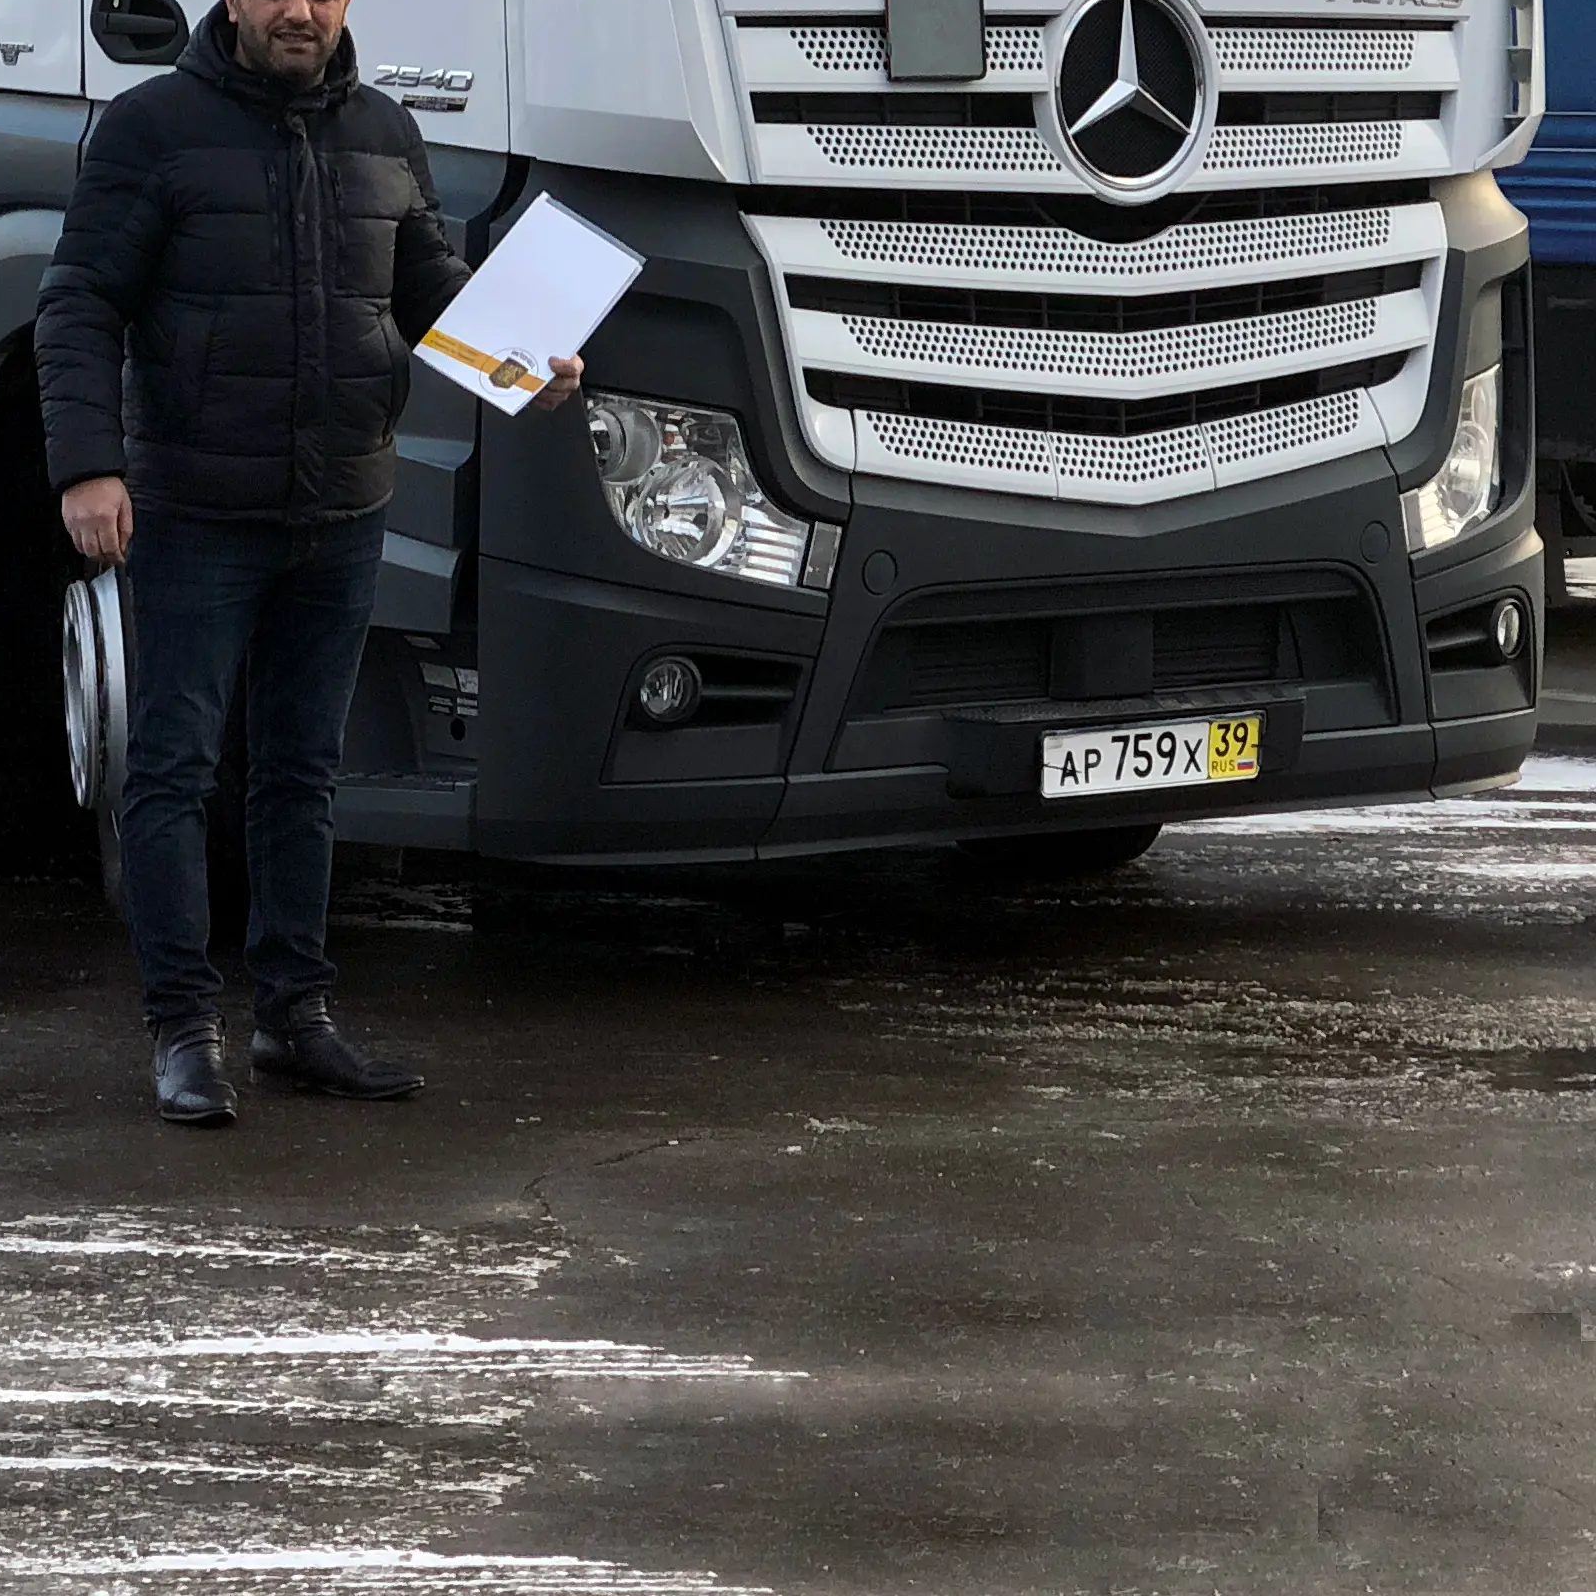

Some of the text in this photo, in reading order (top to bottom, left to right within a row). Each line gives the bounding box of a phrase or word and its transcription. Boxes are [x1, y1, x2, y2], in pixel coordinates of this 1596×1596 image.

[373, 64, 475, 92] 2540
[1214, 722, 1249, 758] 39
[1211, 759, 1236, 774] RUS
